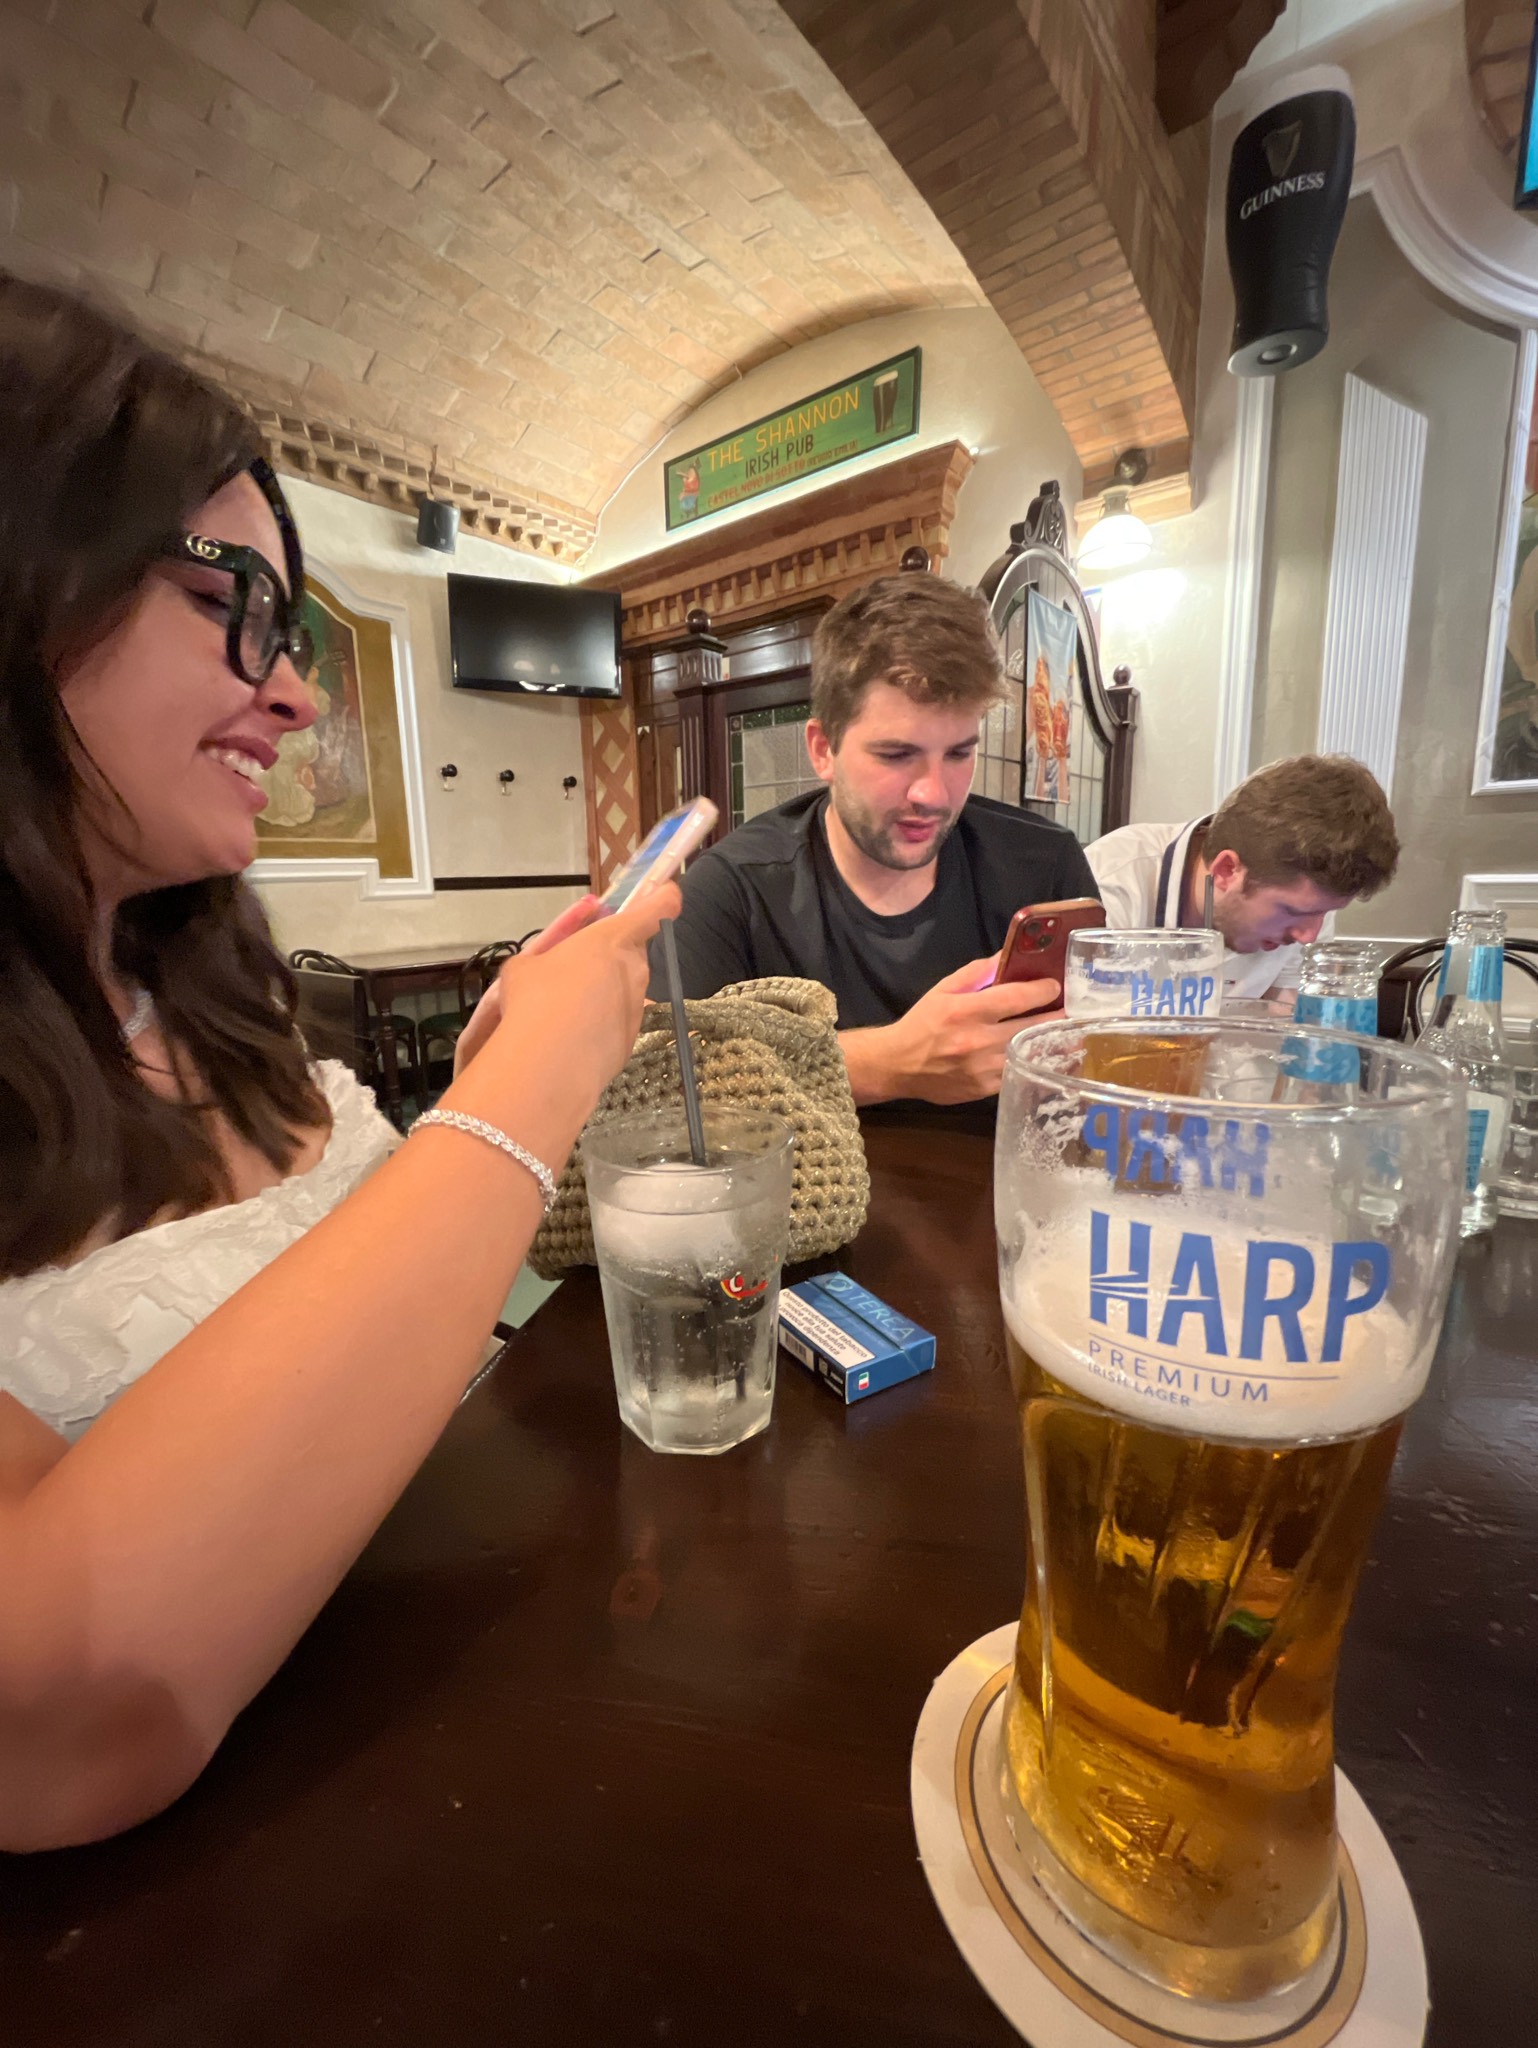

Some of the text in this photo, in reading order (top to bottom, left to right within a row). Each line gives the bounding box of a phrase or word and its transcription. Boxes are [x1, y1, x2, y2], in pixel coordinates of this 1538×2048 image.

[1240, 171, 1326, 220] GUINNESS
[709, 386, 860, 472] THE SHANNON
[745, 434, 814, 479] IRISH PUB
[1130, 976, 1214, 1016] HARP
[1088, 1210, 1390, 1364] HARP
[802, 1306, 830, 1328] prodotto
[828, 1326, 842, 1336] del
[839, 1335, 868, 1358] tabacco
[850, 1293, 914, 1340] TEREA
[825, 1334, 847, 1351] salute
[1088, 1362, 1191, 1407] IRISH LAGER
[1089, 1340, 1268, 1402] PREMIUM
